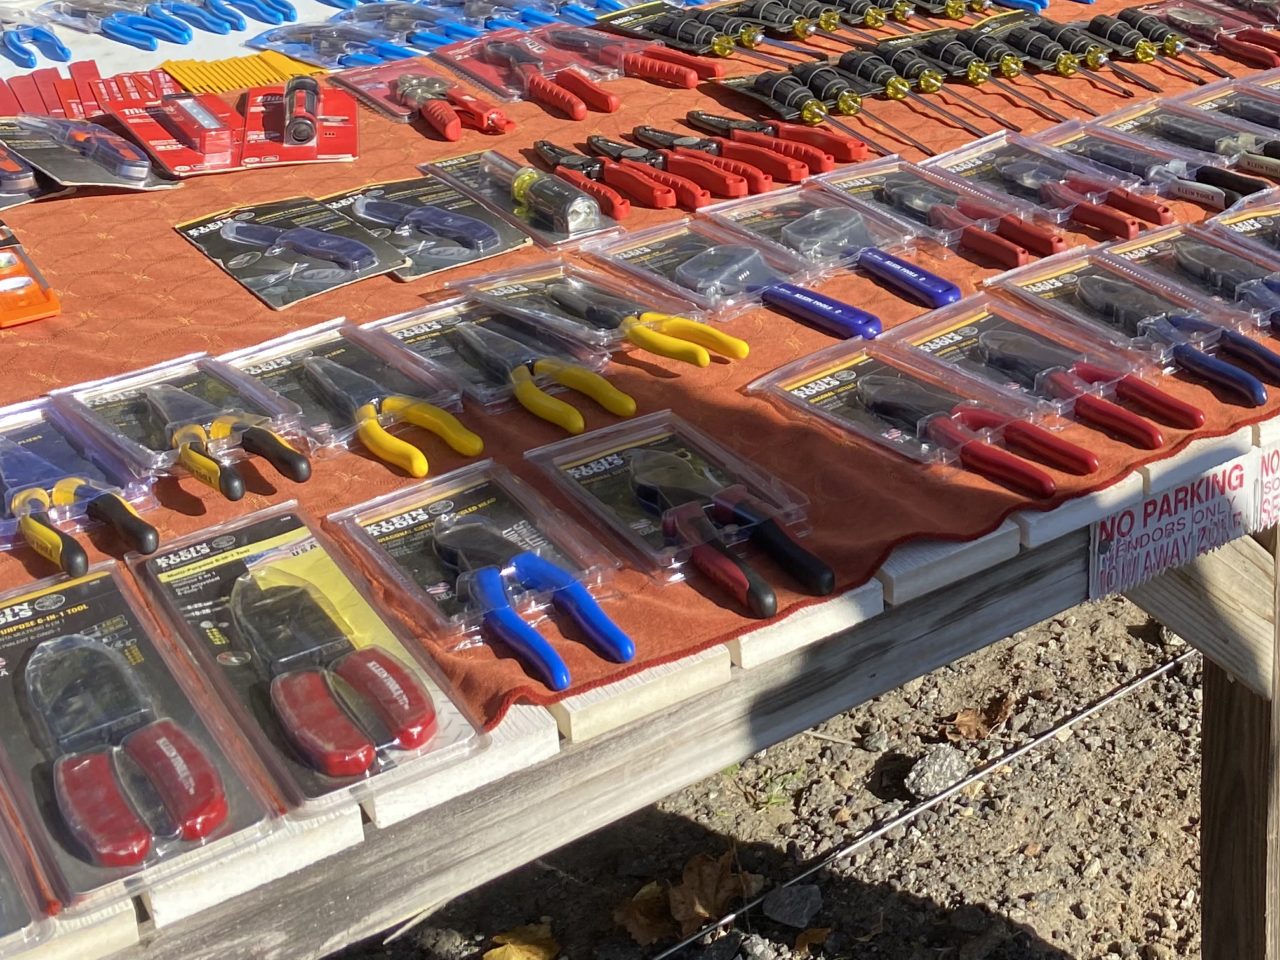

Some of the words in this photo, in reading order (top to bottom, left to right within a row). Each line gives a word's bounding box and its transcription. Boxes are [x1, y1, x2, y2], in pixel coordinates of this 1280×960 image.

[1246, 160, 1263, 170] KLEIN
[1177, 185, 1194, 197] KLEIN
[1194, 189, 1215, 202] TOOLS
[1261, 449, 1280, 477] NO
[1098, 509, 1136, 543] NO
[1143, 463, 1245, 529] PARKING
[1193, 496, 1237, 525] ONLY
[1261, 495, 1280, 523] SE
[368, 508, 425, 532] KLEIN
[370, 513, 429, 538] TOOLS
[291, 543, 318, 558] USA
[1142, 531, 1193, 577] AWAY
[0, 620, 37, 636] URPOSE
[36, 611, 65, 624] 6-IN-1
[65, 603, 89, 615] TOOL
